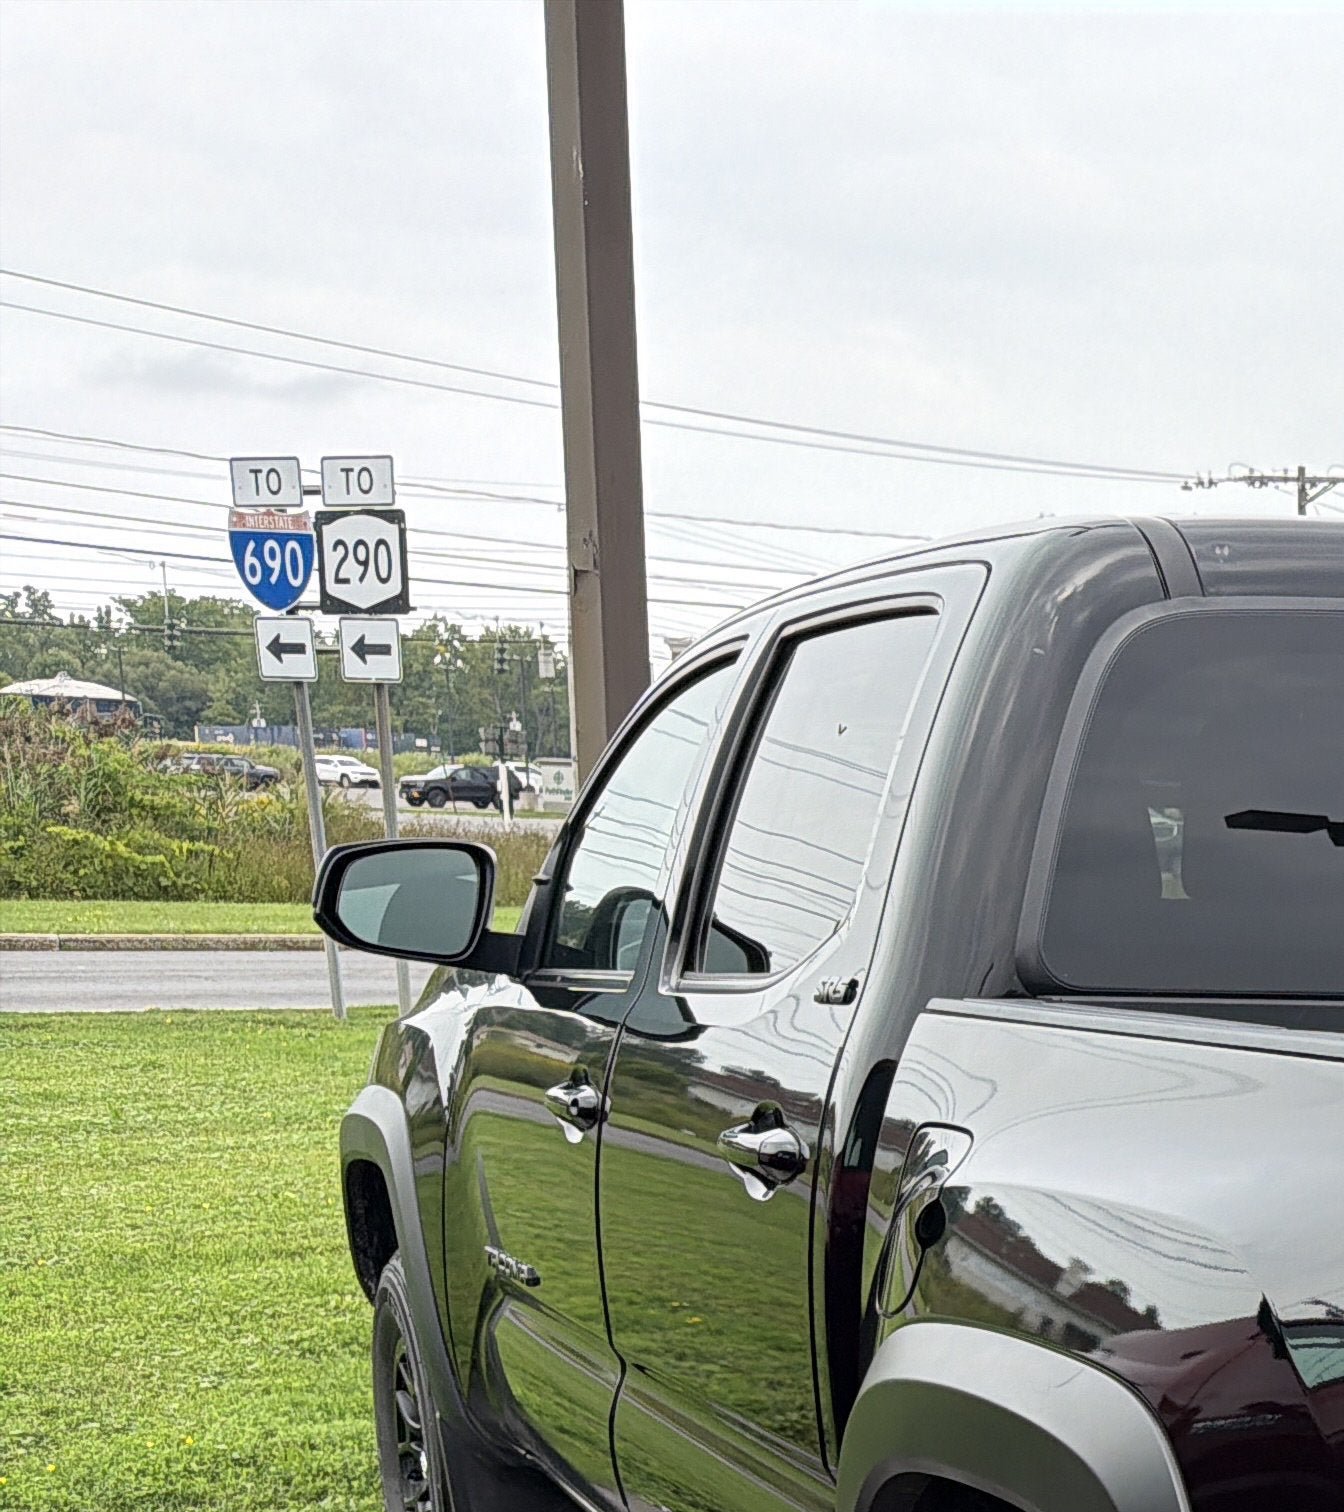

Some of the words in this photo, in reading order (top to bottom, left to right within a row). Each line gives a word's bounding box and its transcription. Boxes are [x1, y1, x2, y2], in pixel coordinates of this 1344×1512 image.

[248, 467, 282, 496] TO
[339, 466, 374, 495] TO
[246, 514, 294, 530] INTERSTATE
[243, 539, 304, 587] 690
[331, 538, 393, 584] 290
